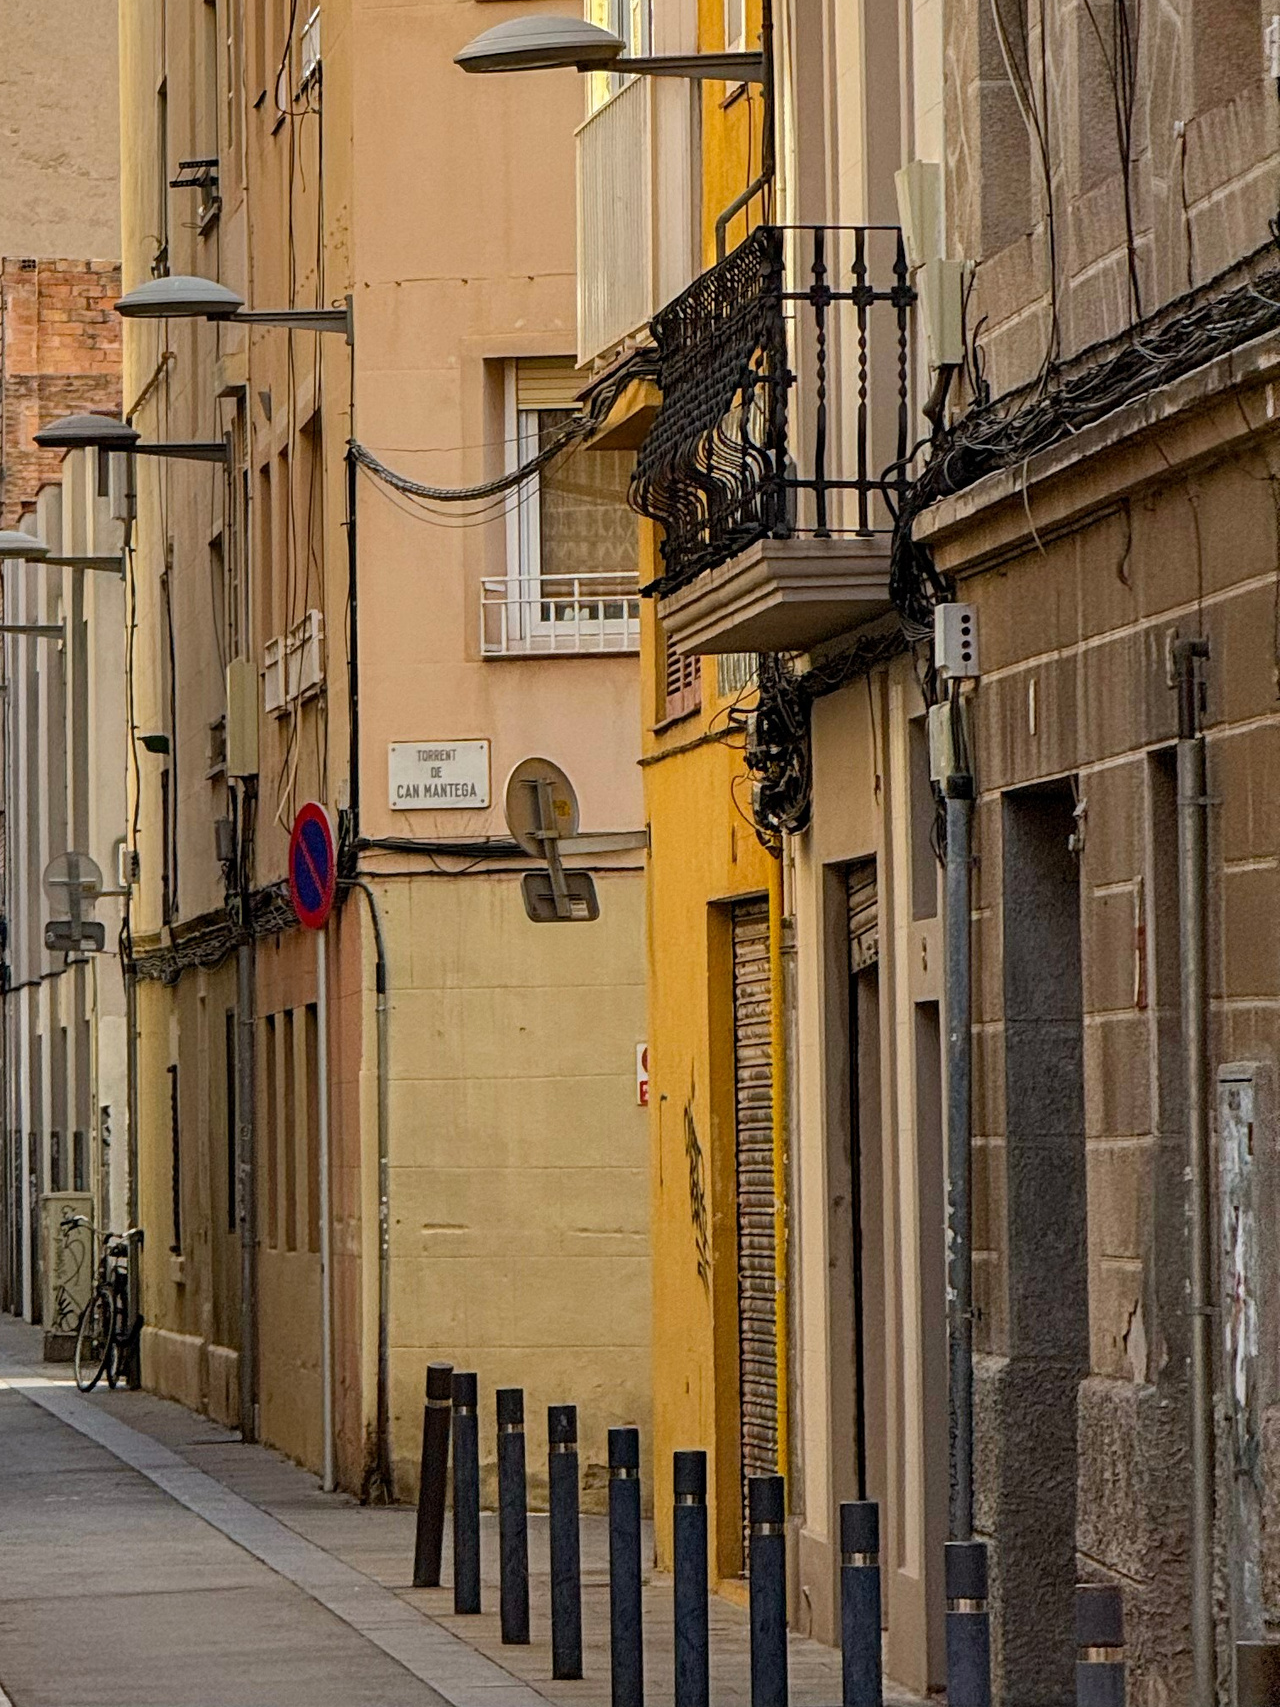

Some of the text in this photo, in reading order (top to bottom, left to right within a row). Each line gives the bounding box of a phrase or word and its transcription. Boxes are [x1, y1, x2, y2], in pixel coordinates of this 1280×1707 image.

[416, 749, 457, 762] TORRENT
[430, 766, 442, 778] DE
[396, 782, 477, 799] CAN MANTEGA
